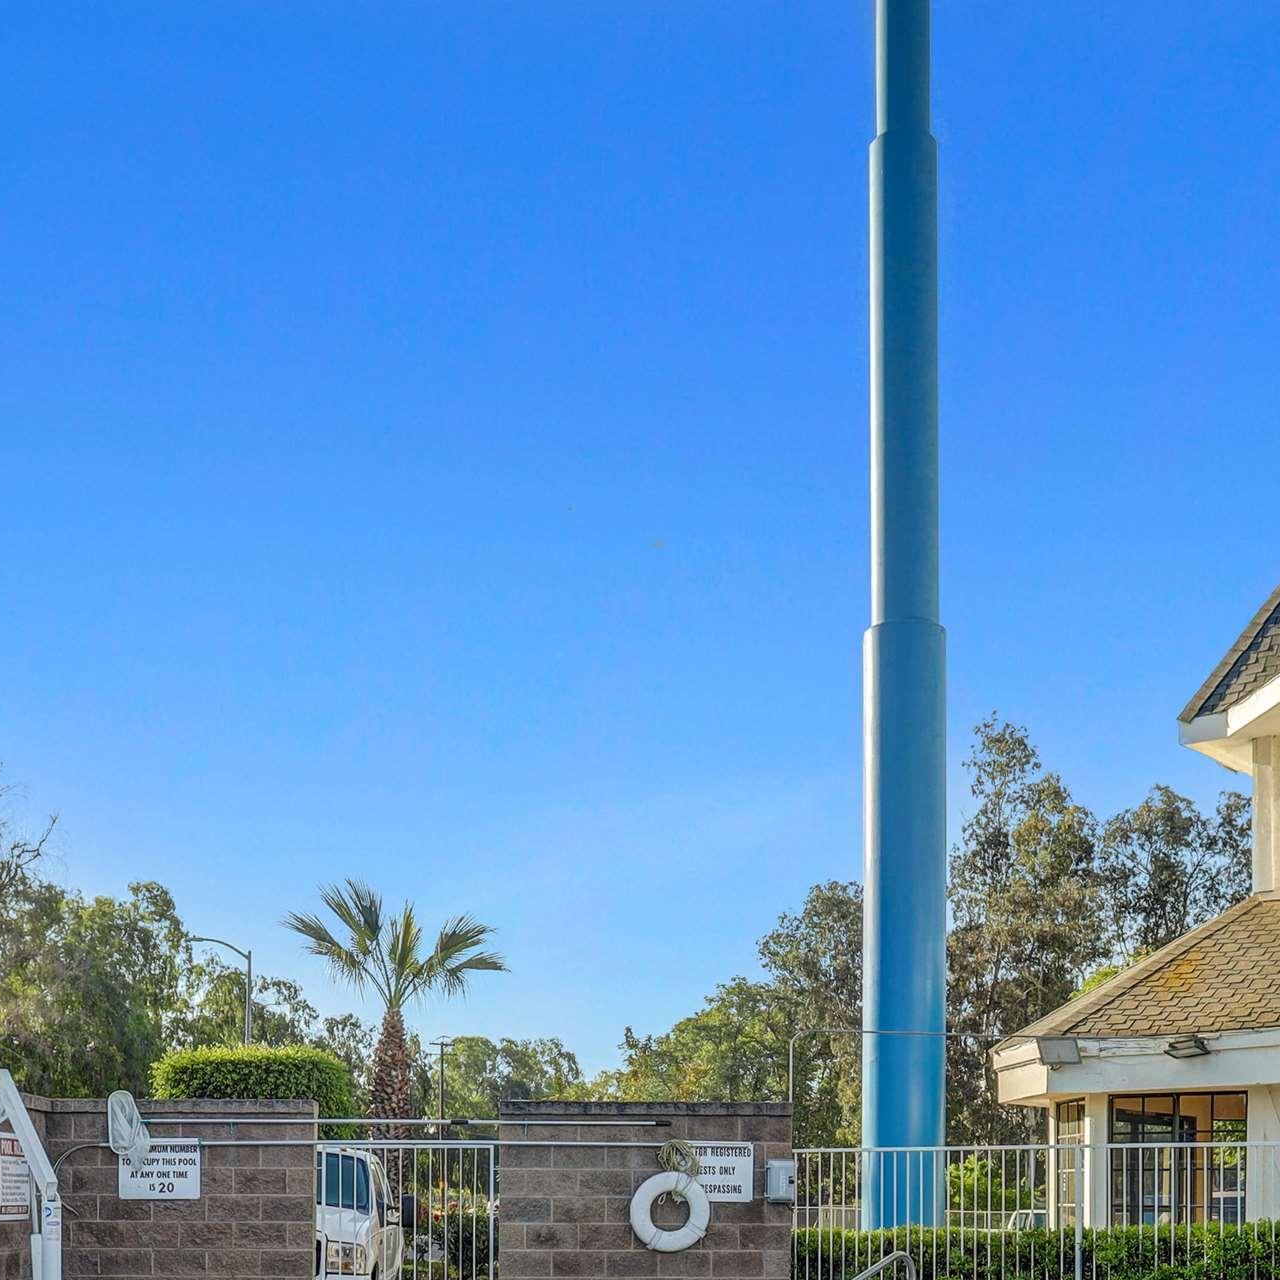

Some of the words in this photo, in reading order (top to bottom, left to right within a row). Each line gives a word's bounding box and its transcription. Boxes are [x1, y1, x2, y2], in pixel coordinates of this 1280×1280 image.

[169, 1144, 198, 1153] NUMBER
[710, 1146, 752, 1157] REGISTERED
[122, 1158, 131, 1166] TO
[162, 1158, 176, 1166] THIS
[178, 1158, 197, 1166] POOL
[130, 1171, 138, 1179] AT
[140, 1171, 154, 1179] ANY
[156, 1171, 170, 1179] ONE
[172, 1171, 188, 1179] TIME
[719, 1166, 736, 1176] ONLY
[149, 1183, 156, 1191] IS
[158, 1182, 175, 1193] 20
[701, 1183, 742, 1194] ESPASSING
